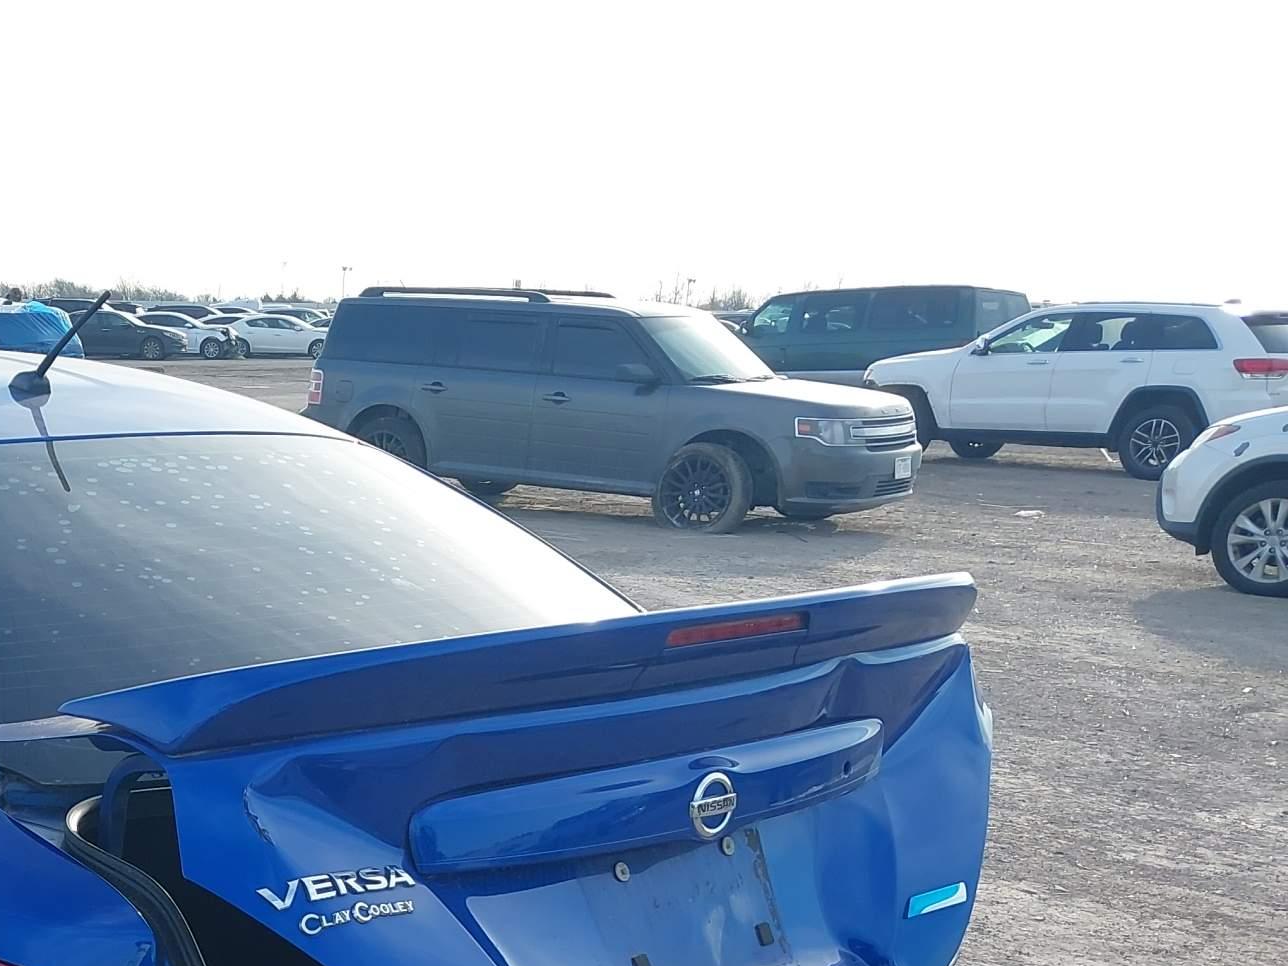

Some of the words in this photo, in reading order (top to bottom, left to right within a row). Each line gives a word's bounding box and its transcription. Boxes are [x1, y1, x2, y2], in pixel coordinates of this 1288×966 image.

[697, 797, 734, 816] NISSAN
[256, 865, 416, 911] VERSA
[299, 910, 351, 935] CLAY
[353, 901, 415, 923] COOLEY
